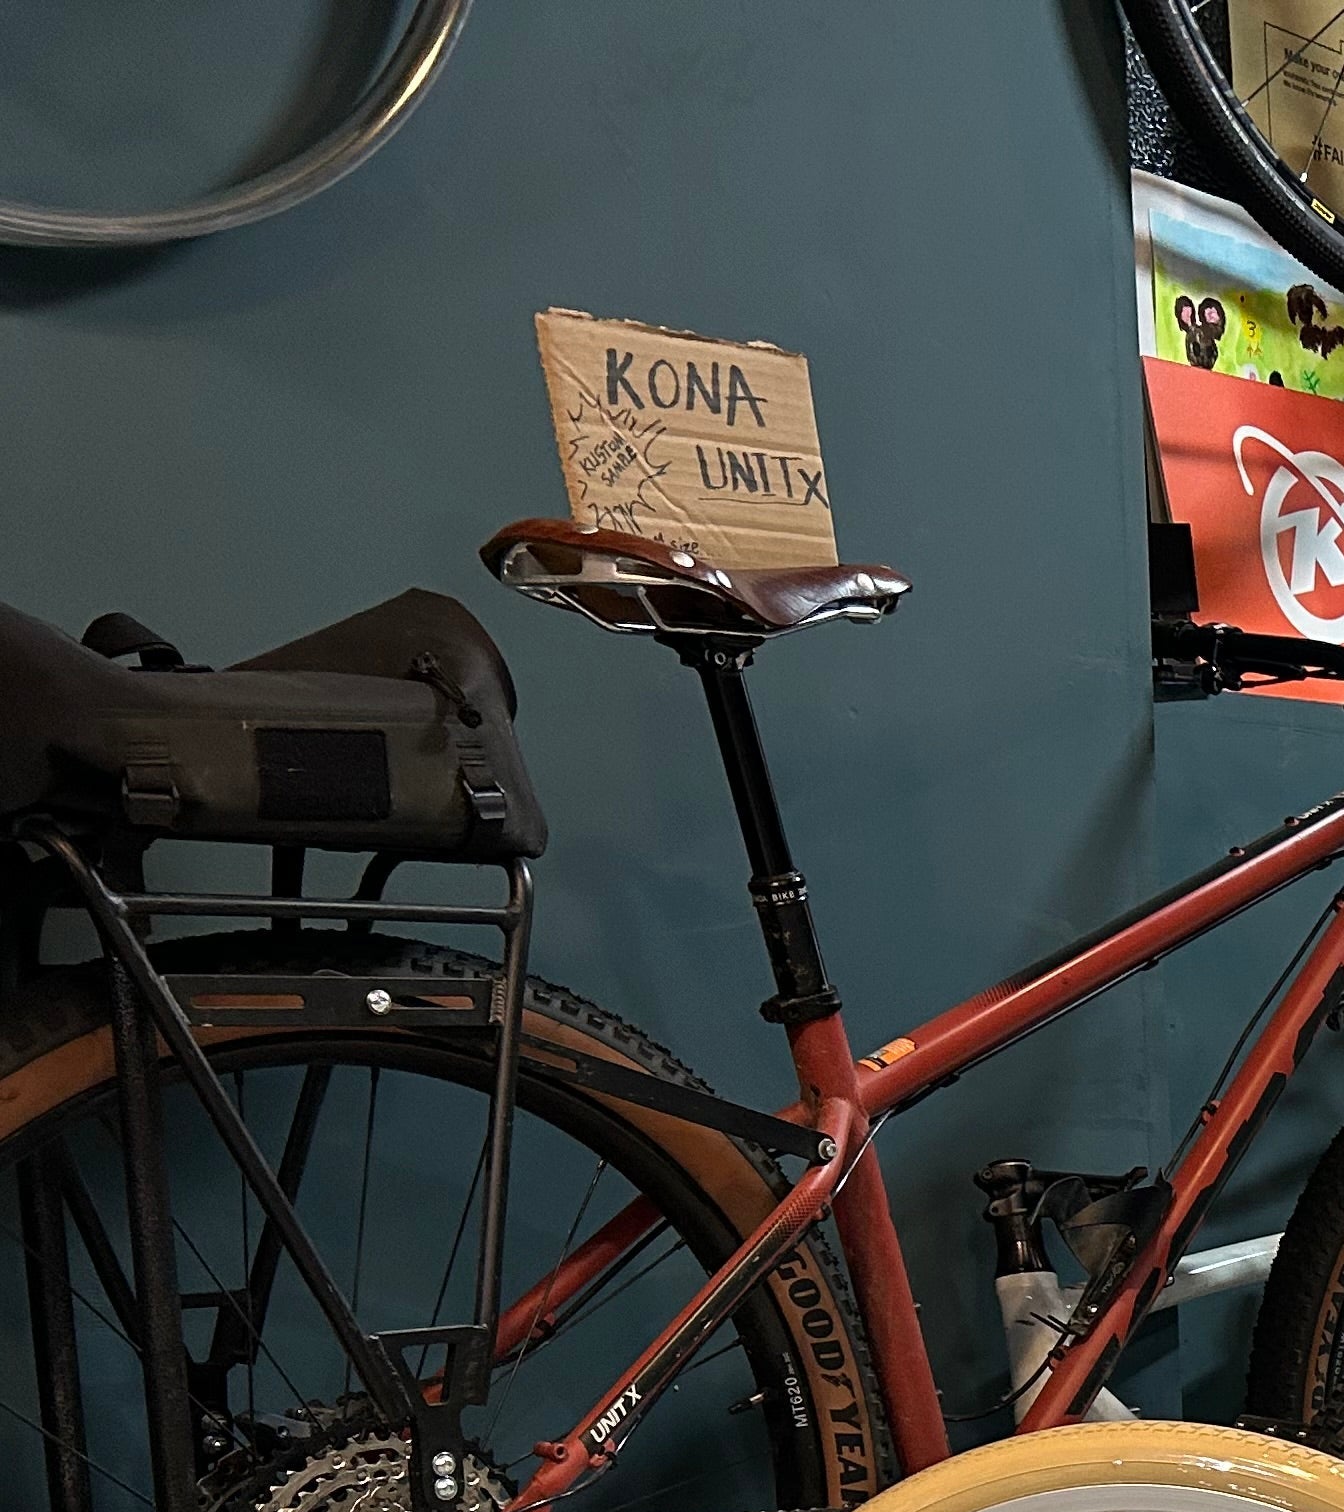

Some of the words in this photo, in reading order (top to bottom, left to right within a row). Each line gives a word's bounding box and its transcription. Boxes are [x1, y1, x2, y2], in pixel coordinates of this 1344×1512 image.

[606, 348, 766, 427] KONA
[590, 1397, 627, 1443] UNIT
[786, 1376, 809, 1429] MT620
